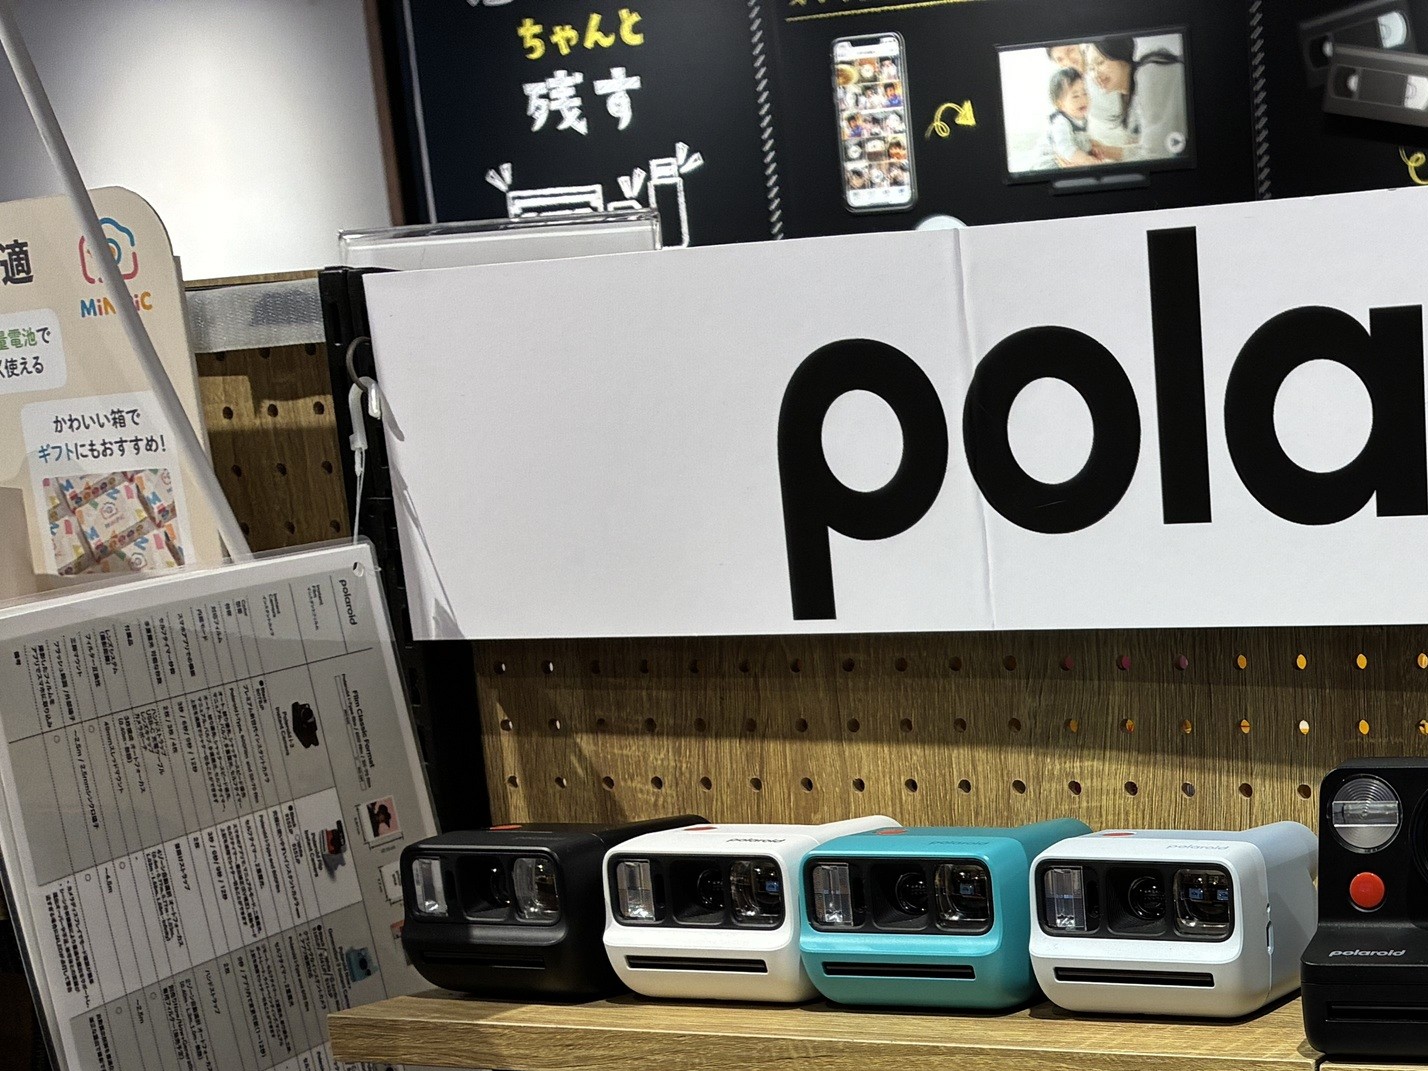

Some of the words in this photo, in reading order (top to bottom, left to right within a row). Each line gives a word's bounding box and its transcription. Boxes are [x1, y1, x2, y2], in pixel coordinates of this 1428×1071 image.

[517, 7, 644, 60] ちゃんと
[522, 67, 641, 136] 残す
[53, 408, 141, 433] かわいい箱で
[338, 578, 357, 626] polaroid
[1328, 949, 1406, 958] polaroid
